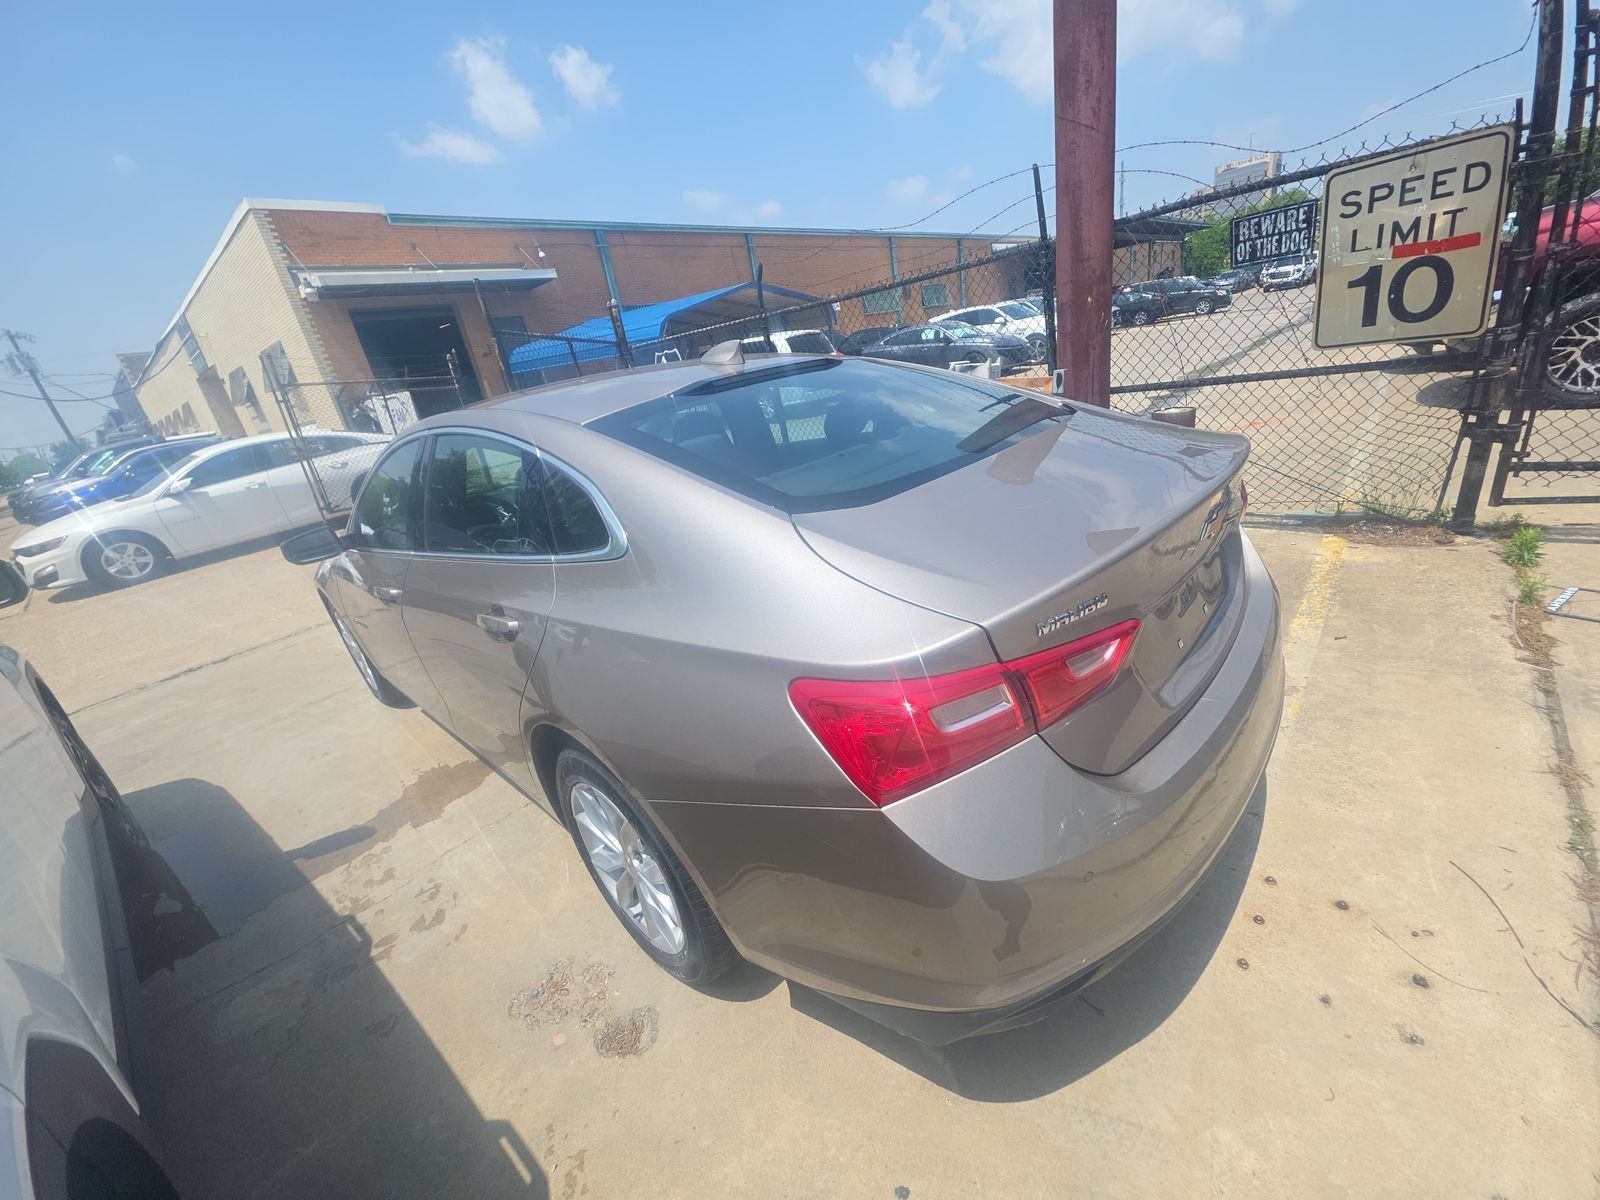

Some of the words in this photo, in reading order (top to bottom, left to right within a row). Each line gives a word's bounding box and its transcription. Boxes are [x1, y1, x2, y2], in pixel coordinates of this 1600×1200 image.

[1339, 161, 1492, 219] SPEED
[1236, 241, 1252, 261] OF
[1255, 235, 1279, 257] THE
[1281, 229, 1309, 253] DOG
[1239, 207, 1308, 241] BEWARE
[1350, 206, 1468, 253] LIMIT
[1347, 255, 1455, 328] 10
[1036, 592, 1108, 636] MALIBU
